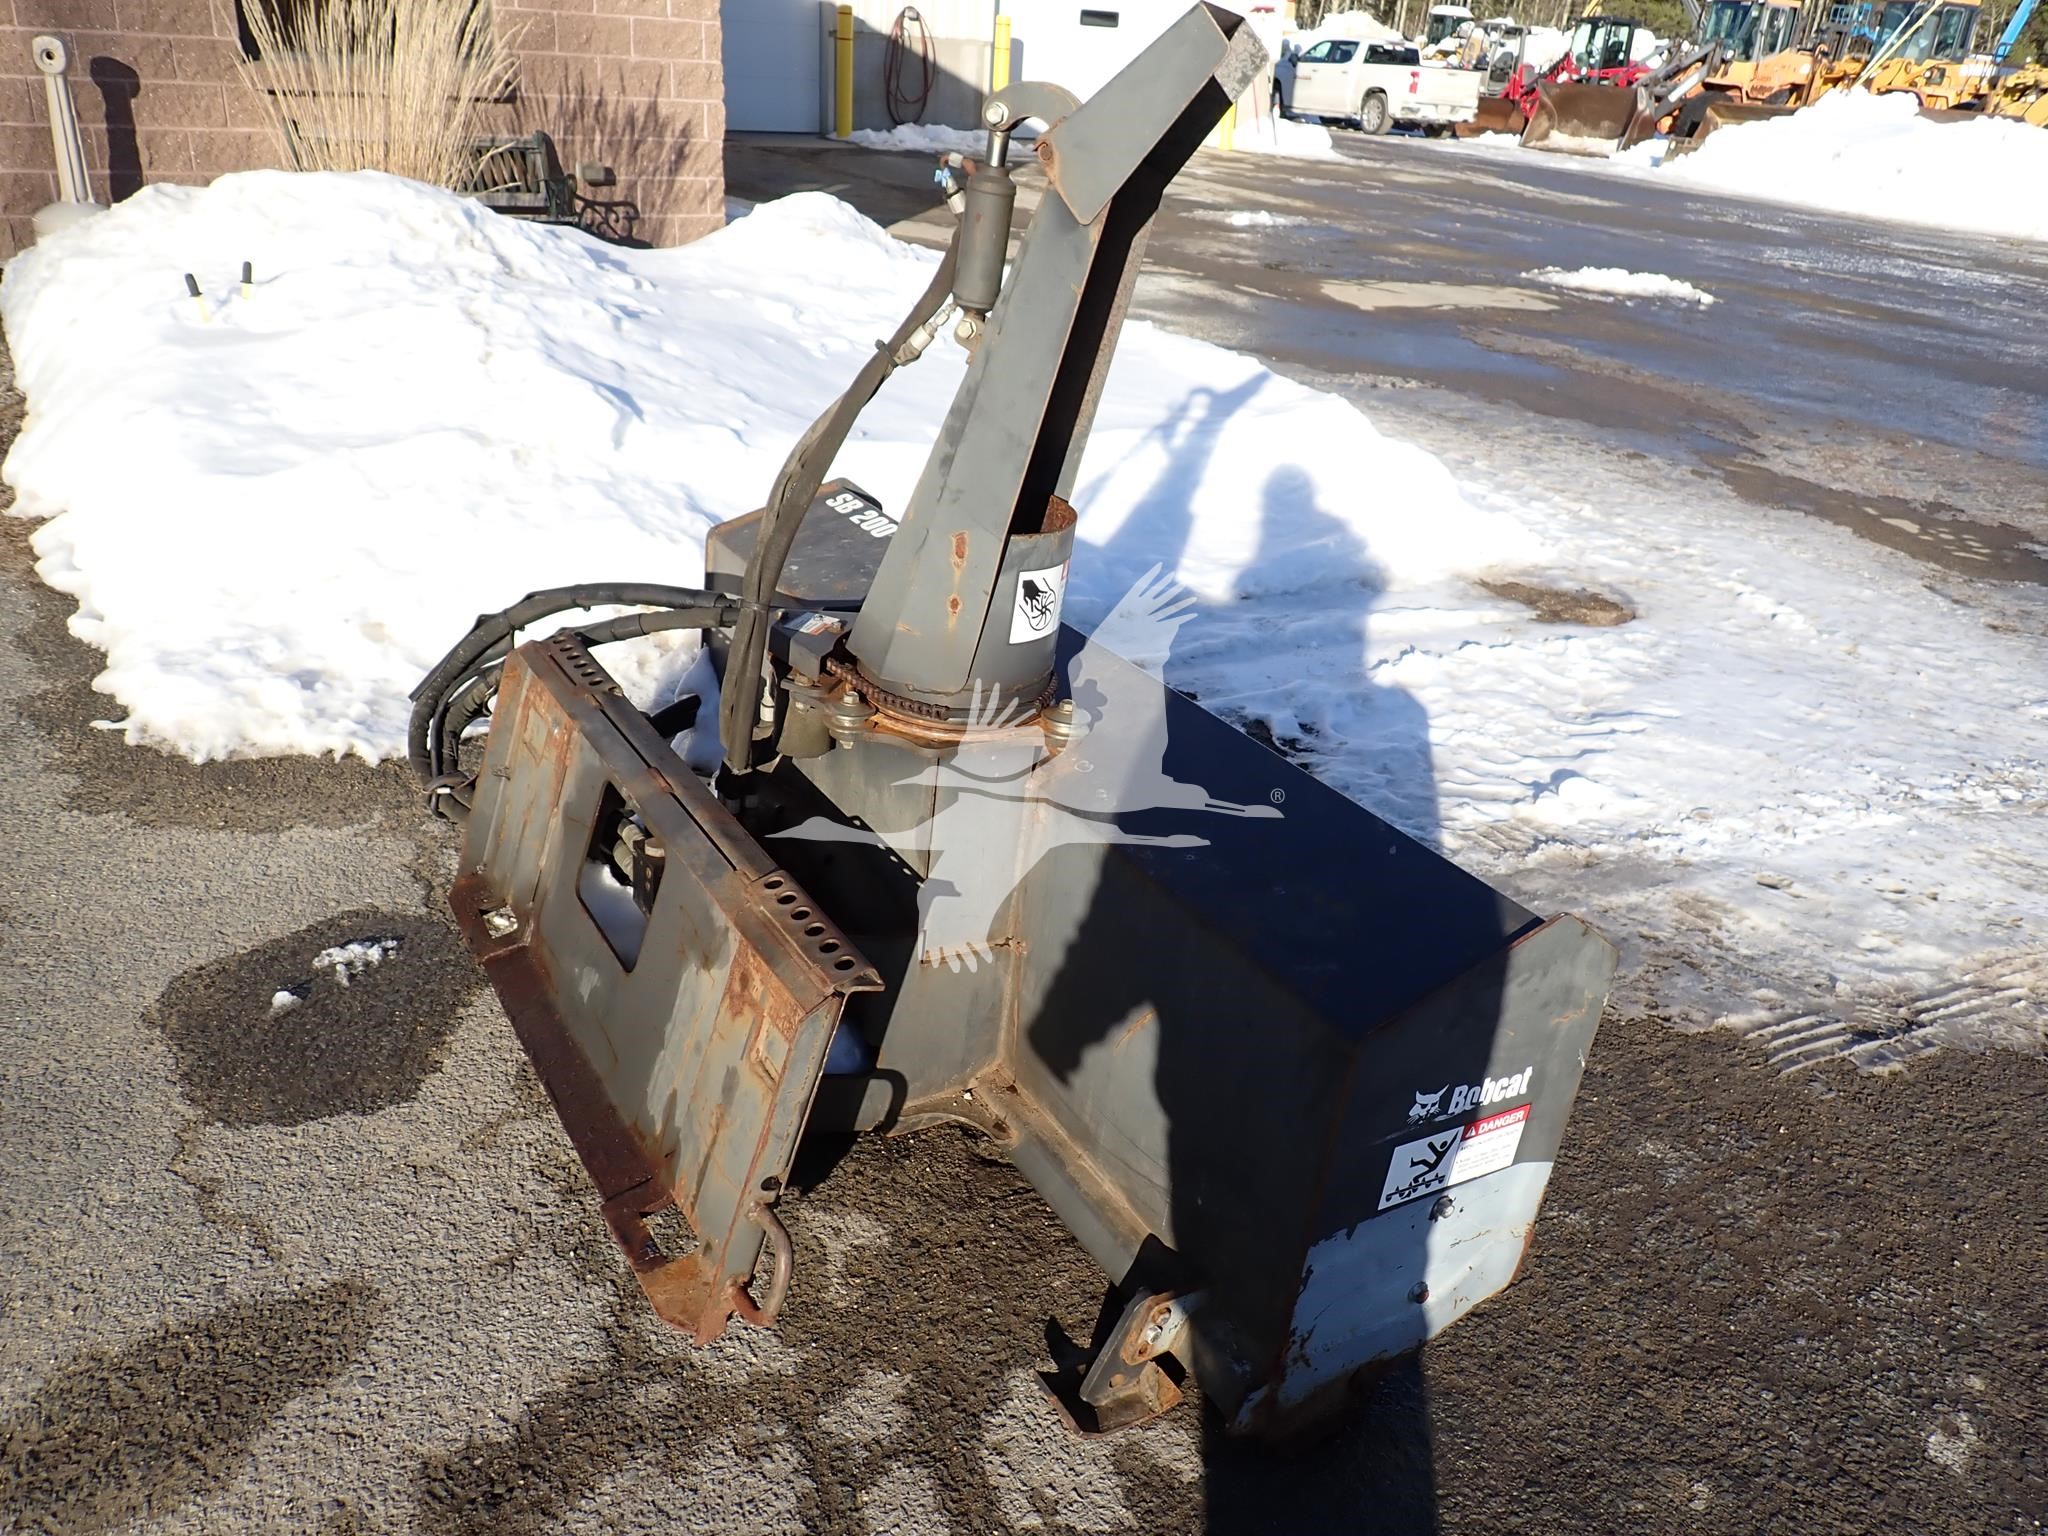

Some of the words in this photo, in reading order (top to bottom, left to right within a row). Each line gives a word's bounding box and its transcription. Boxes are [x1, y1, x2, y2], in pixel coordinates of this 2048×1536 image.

[825, 493, 864, 514] SB
[849, 510, 898, 538] 200
[1448, 1066, 1533, 1115] Bobcat
[1478, 1110, 1525, 1134] DANGER
